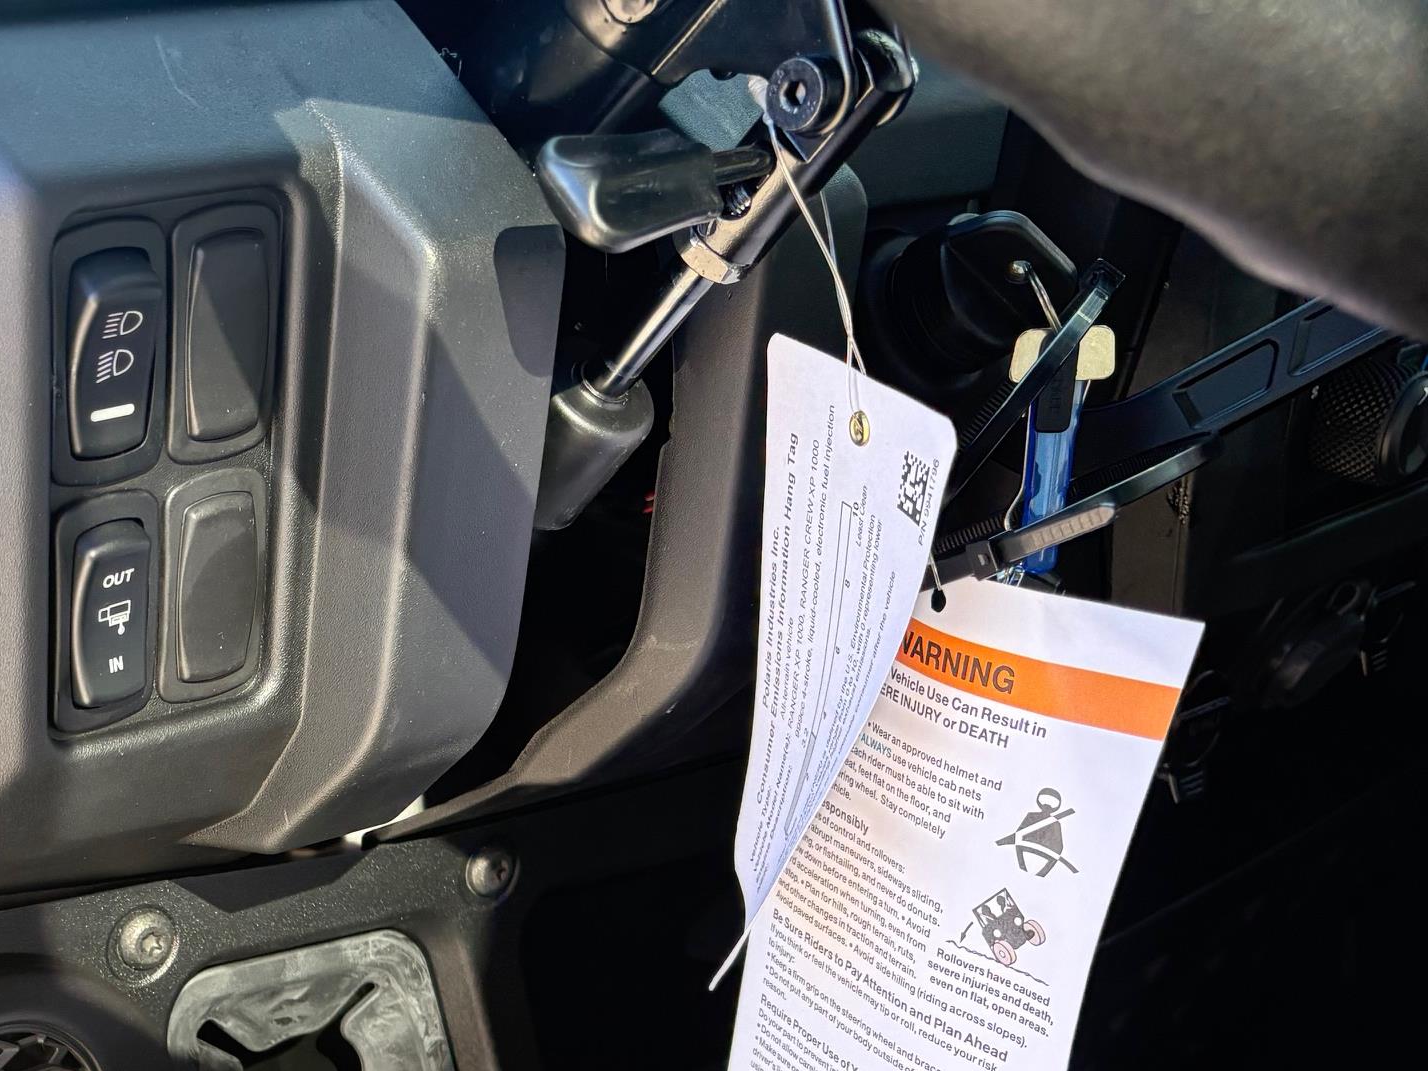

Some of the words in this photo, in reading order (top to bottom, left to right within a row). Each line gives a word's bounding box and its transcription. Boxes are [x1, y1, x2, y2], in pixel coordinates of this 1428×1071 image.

[787, 433, 798, 465] Tag
[824, 404, 835, 461] injection
[784, 472, 796, 520] Hang
[809, 476, 816, 497] XP
[822, 465, 830, 489] fuel
[918, 520, 927, 546] P/N
[924, 458, 940, 518] 9941796
[771, 527, 779, 556] Inc.
[805, 499, 814, 544] CREW
[816, 492, 827, 556] electronic
[102, 568, 134, 588] OUT
[777, 525, 790, 626] Information
[800, 548, 810, 609] RANGER
[807, 561, 821, 643] liquid-cooled,
[766, 562, 778, 647] Industries
[797, 614, 805, 644] 1000,
[108, 656, 124, 674] IN
[762, 651, 772, 708] Polaris
[771, 631, 783, 717] Emissions
[795, 649, 801, 668] XP
[802, 647, 813, 699] 4-stroke,
[780, 663, 790, 720] All-terrain
[788, 671, 800, 729] RANGER
[795, 701, 805, 737] 999cc
[892, 667, 925, 696] Vehicle
[926, 685, 949, 706] Use
[951, 697, 978, 717] Can
[981, 707, 1029, 733] Result
[1031, 725, 1046, 738] in
[900, 693, 942, 723] INJURY
[942, 717, 957, 730] or
[958, 720, 1009, 748] DEATH
[756, 720, 775, 804] Consumer
[860, 734, 892, 758] ALWAYS
[892, 753, 906, 767] use
[907, 761, 937, 783] vehicle
[938, 777, 957, 791] cab
[958, 786, 981, 801] nets
[872, 722, 893, 741] Wear
[891, 736, 901, 747] an
[901, 742, 942, 768] approved
[943, 760, 979, 783] helmet
[980, 777, 1002, 791] and
[851, 780, 878, 800] wheel.
[880, 794, 898, 813] Stay
[898, 807, 945, 839] completely
[856, 764, 872, 780] feet
[869, 773, 885, 788] flat
[885, 783, 895, 794] on
[893, 787, 909, 802] the
[910, 795, 930, 815] floor,
[932, 809, 951, 823] and
[867, 754, 885, 771] rider
[885, 766, 908, 783] must
[905, 775, 916, 789] be
[916, 784, 936, 799] able
[937, 792, 947, 804] to
[948, 798, 961, 810] sit
[962, 804, 984, 820] with
[874, 866, 910, 894] sideways
[911, 889, 943, 913] sliding,
[896, 895, 906, 907] do
[907, 902, 940, 927] donuts.
[772, 908, 787, 924] Be
[784, 917, 803, 939] Sure
[804, 932, 833, 960] Riders
[834, 953, 844, 967] to
[844, 960, 862, 981] Pay
[862, 974, 907, 1012] Attention
[909, 1007, 932, 1025] and
[934, 1017, 962, 1040] Plan
[964, 1033, 1008, 1062] Ahead
[875, 961, 891, 978] side
[891, 971, 916, 995] hilling
[917, 987, 948, 1012] (riding
[949, 1005, 985, 1027] across
[986, 1022, 1027, 1048] slopes).
[927, 960, 960, 980] severe
[962, 973, 1000, 997] injuries
[1001, 993, 1022, 1007] and
[1022, 1002, 1053, 1026] death,
[936, 948, 984, 976] Rollovers
[986, 968, 1011, 988] have
[1013, 983, 1050, 1006] caused
[760, 993, 795, 1026] Require
[792, 1019, 821, 1048] Proper
[822, 1042, 839, 1063] Use
[840, 1059, 853, 1071] of
[841, 1008, 871, 1036] steering
[872, 1031, 896, 1050] wheel
[896, 1046, 914, 1061] and
[929, 975, 953, 992] even
[955, 987, 968, 998] on
[970, 991, 989, 1009] flat,
[991, 1003, 1017, 1020] open
[1018, 1016, 1048, 1037] areas.
[873, 1046, 904, 1070] outside
[900, 1018, 917, 1034] roll,
[918, 1028, 952, 1051] reduce
[953, 1046, 977, 1063] your
